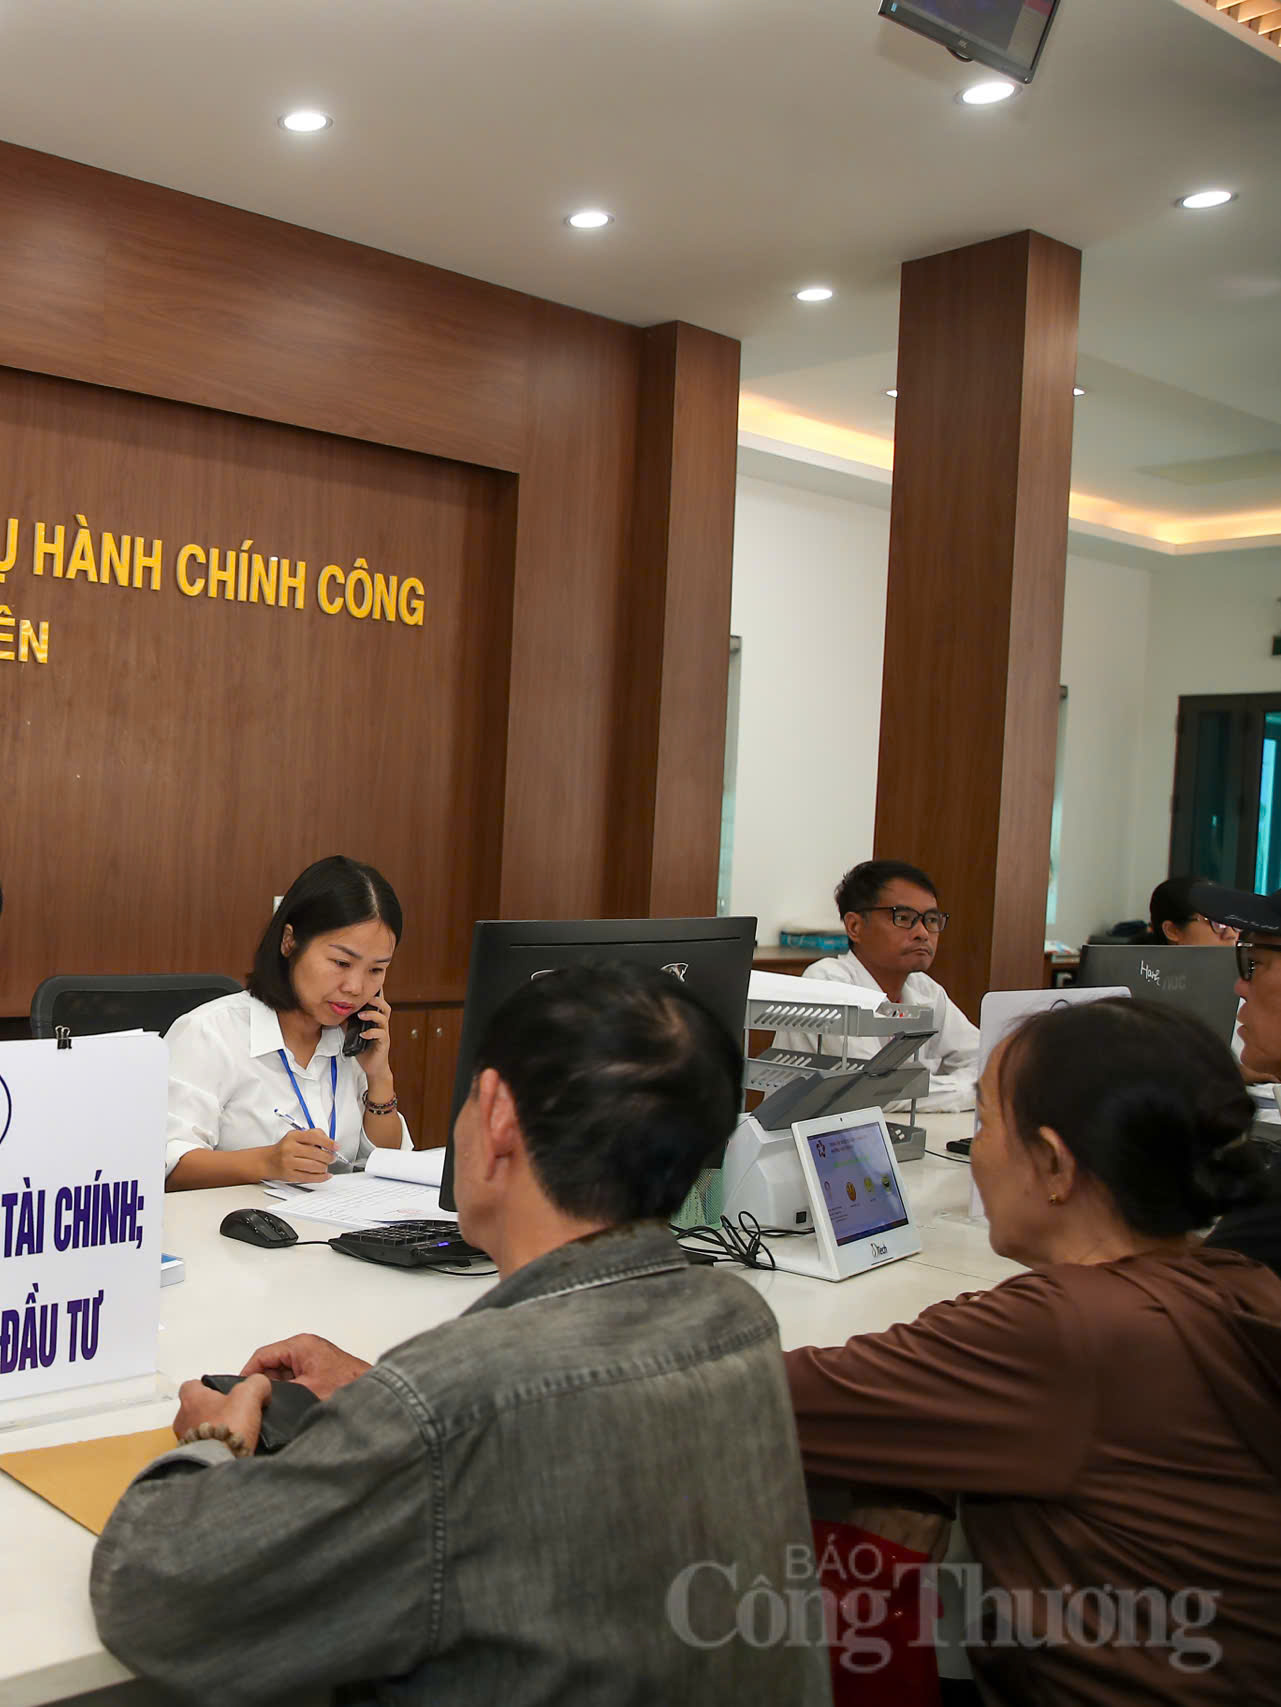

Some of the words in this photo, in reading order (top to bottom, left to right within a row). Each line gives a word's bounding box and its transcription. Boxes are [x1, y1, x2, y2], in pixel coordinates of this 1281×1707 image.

[33, 514, 163, 591] HÀNH
[176, 539, 307, 610] CHÍNH
[318, 557, 425, 627] CÔNG
[1, 1177, 45, 1258] TÀI
[53, 1169, 145, 1252] CHÍNH;
[0, 1283, 58, 1374] ĐẦU
[66, 1290, 105, 1363] TƯ
